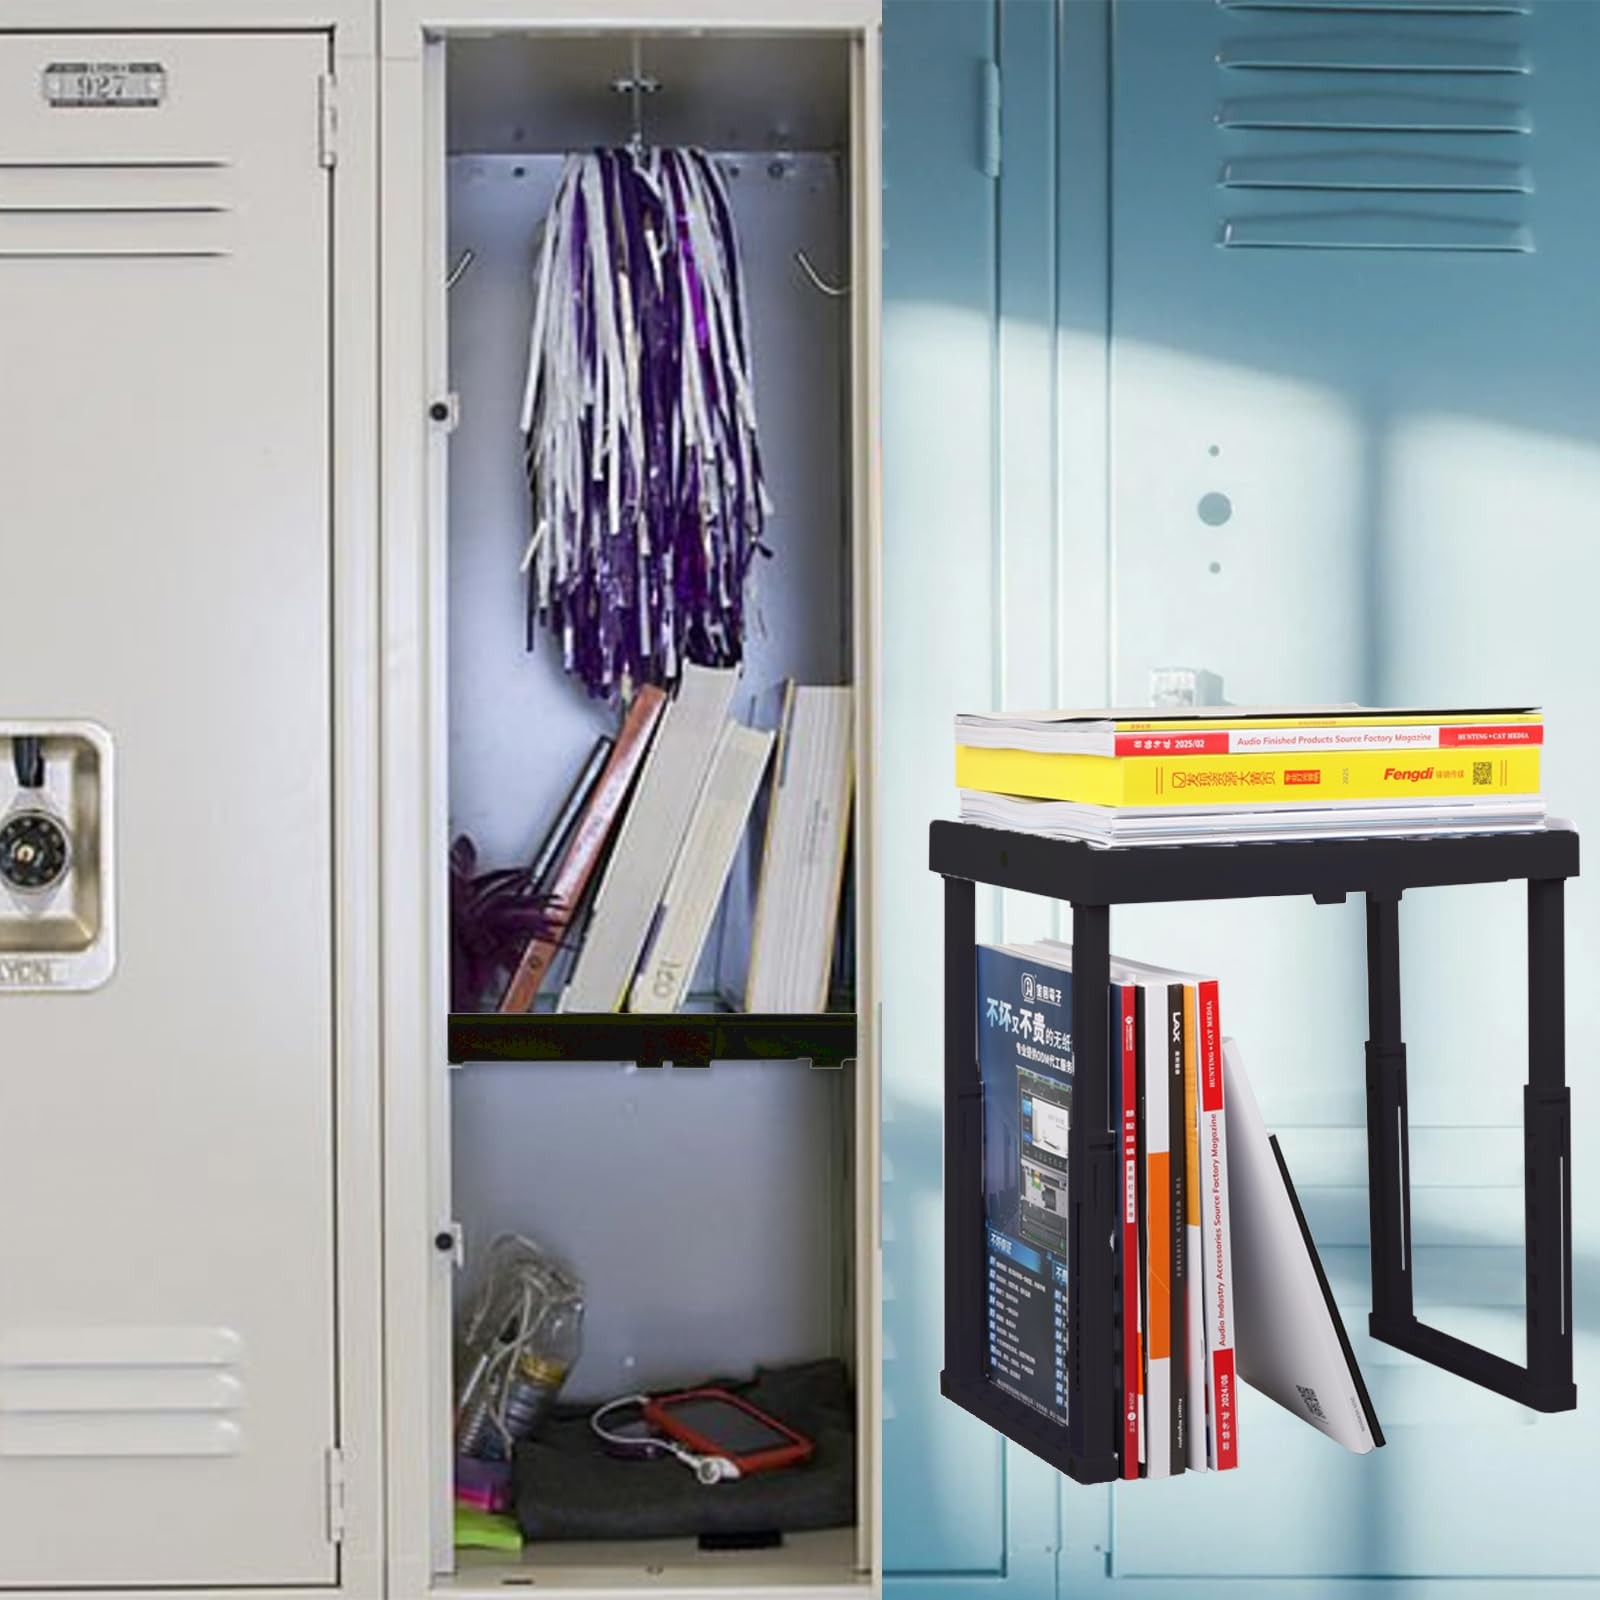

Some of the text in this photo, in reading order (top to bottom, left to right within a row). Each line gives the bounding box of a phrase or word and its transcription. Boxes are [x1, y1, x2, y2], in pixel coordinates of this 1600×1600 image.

[1237, 733, 1432, 745] Audio Finished Products Source Factory Magazine
[1458, 733, 1488, 741] HUNTING
[1384, 767, 1434, 783] Fengdi
[986, 997, 1072, 1052] 不坏又不贵的无纸
[1173, 1012, 1181, 1042] LAX
[1207, 1051, 1215, 1088] HUNTING
[1209, 1113, 1226, 1346] Audio Industry Accessories Source Factory Magazine
